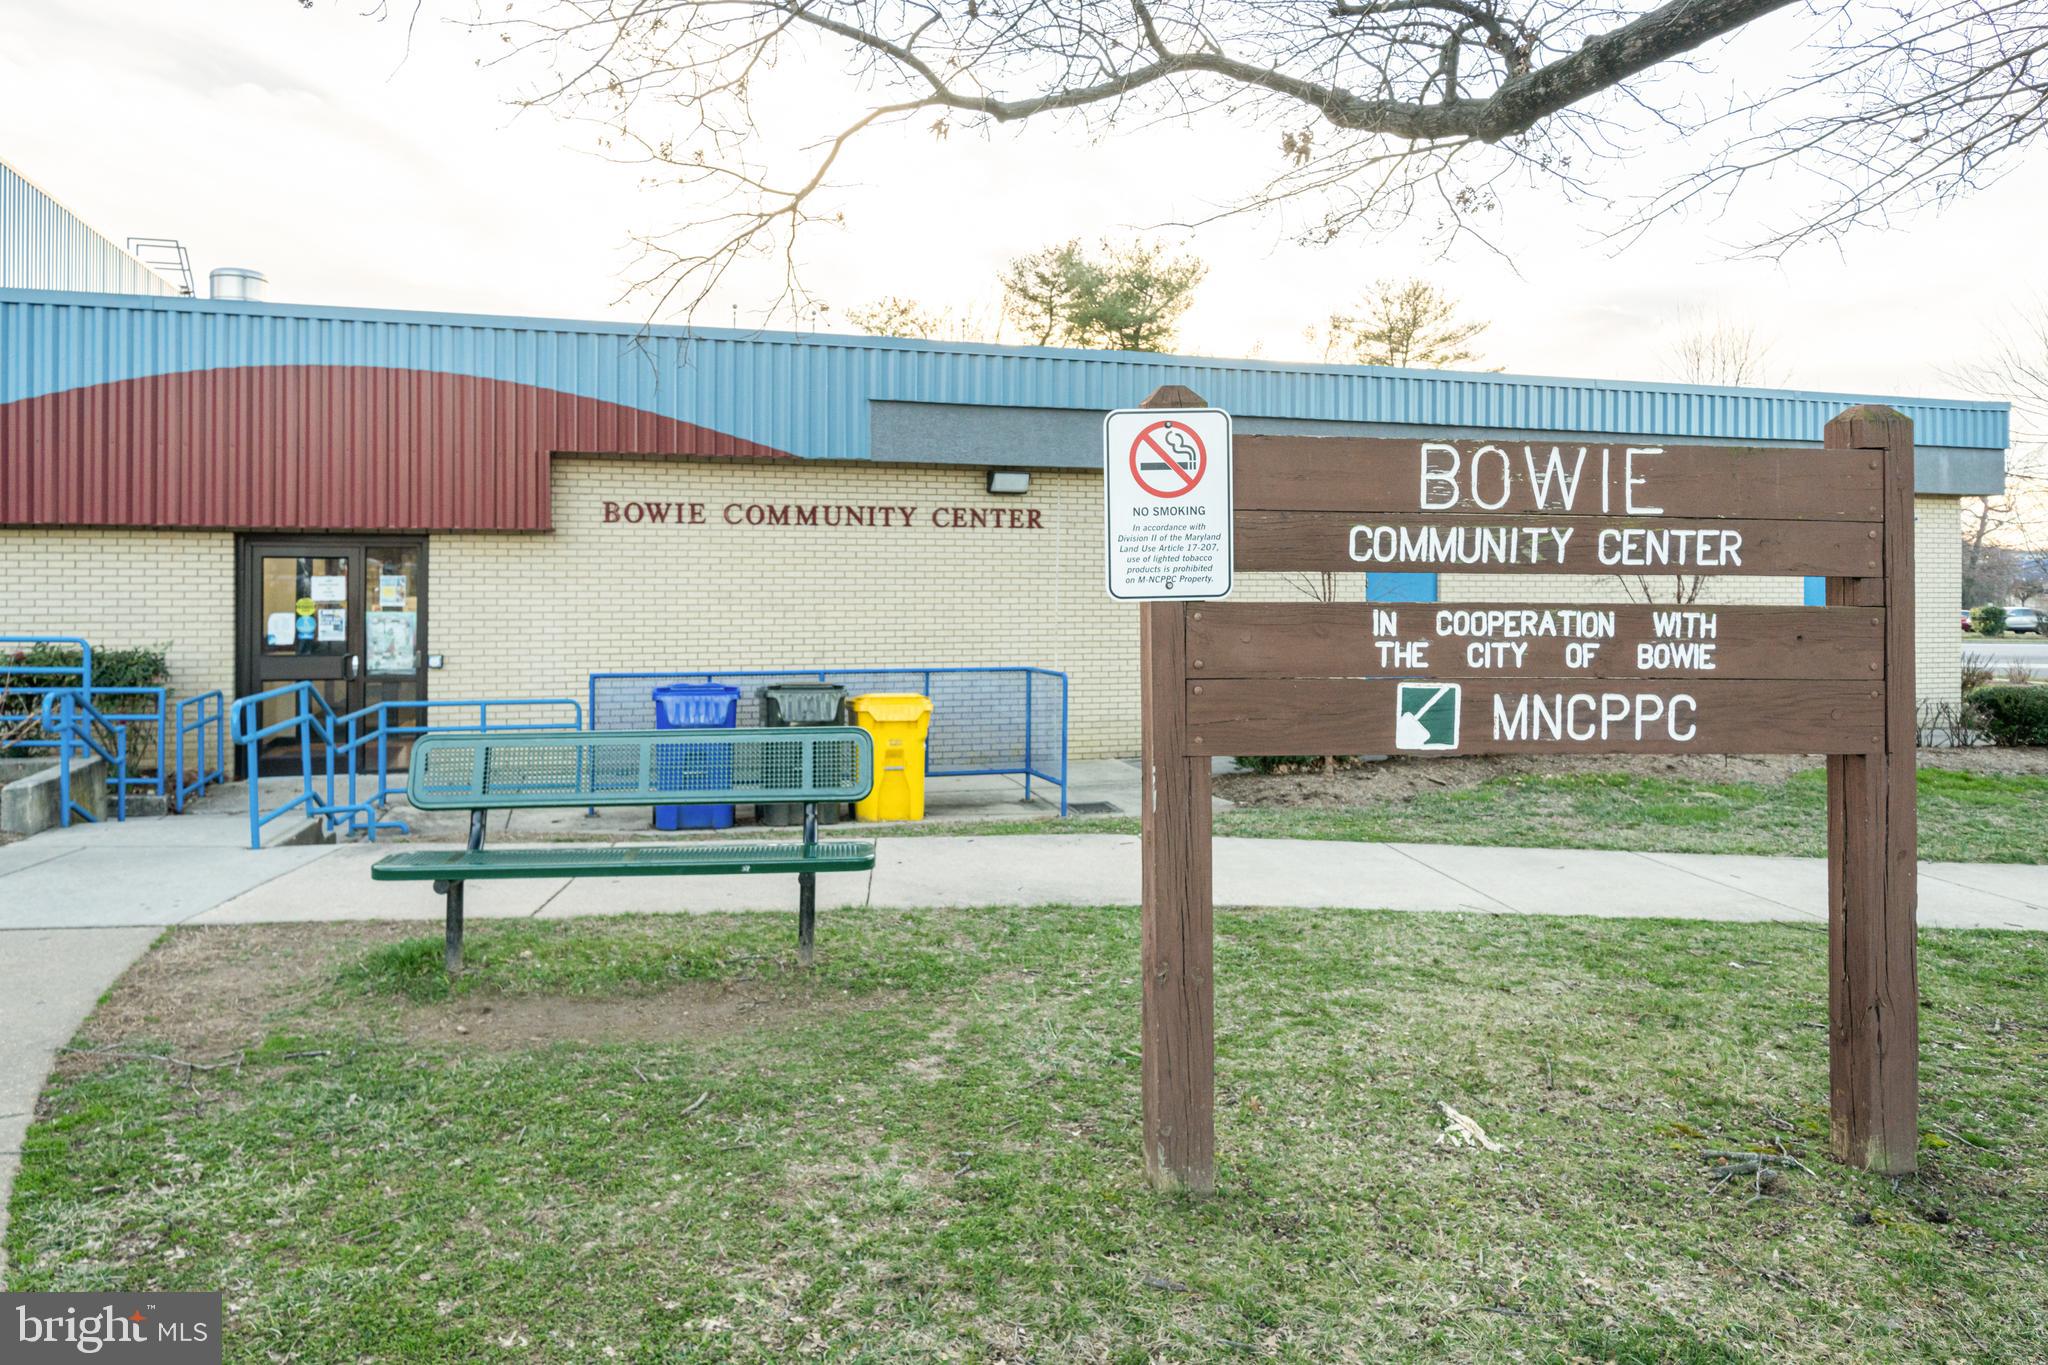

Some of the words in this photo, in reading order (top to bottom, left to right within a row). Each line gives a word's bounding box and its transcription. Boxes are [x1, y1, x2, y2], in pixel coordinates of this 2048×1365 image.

[1420, 443, 1664, 515] BOWIE
[603, 501, 706, 524] BOWIE
[724, 504, 917, 527] COMMUNITY
[932, 507, 1044, 529] CENTER
[1133, 507, 1149, 516] NO
[1153, 506, 1206, 516] SMOKING
[1143, 523, 1187, 531] accordance
[1118, 534, 1148, 542] Division
[1185, 533, 1221, 543] Maryland
[1120, 545, 1139, 553] Land
[1159, 544, 1184, 552] Article
[1187, 543, 1219, 552] 17-207,
[1349, 525, 1574, 564] COMMUNITY
[1598, 529, 1742, 566] CENTER
[1153, 555, 1180, 564] lighted
[1127, 566, 1160, 574] products
[1173, 564, 1213, 573] prohibited
[1179, 575, 1213, 584] Property.
[1373, 609, 1397, 636] IN
[1436, 610, 1614, 638] COOPERATION
[1653, 612, 1716, 639] WITH
[1375, 641, 1429, 668] THE
[1467, 642, 1528, 669] CITY
[1566, 643, 1600, 669] OF
[1637, 643, 1716, 670] BOWIE
[1494, 694, 1697, 742] MNCPPC
